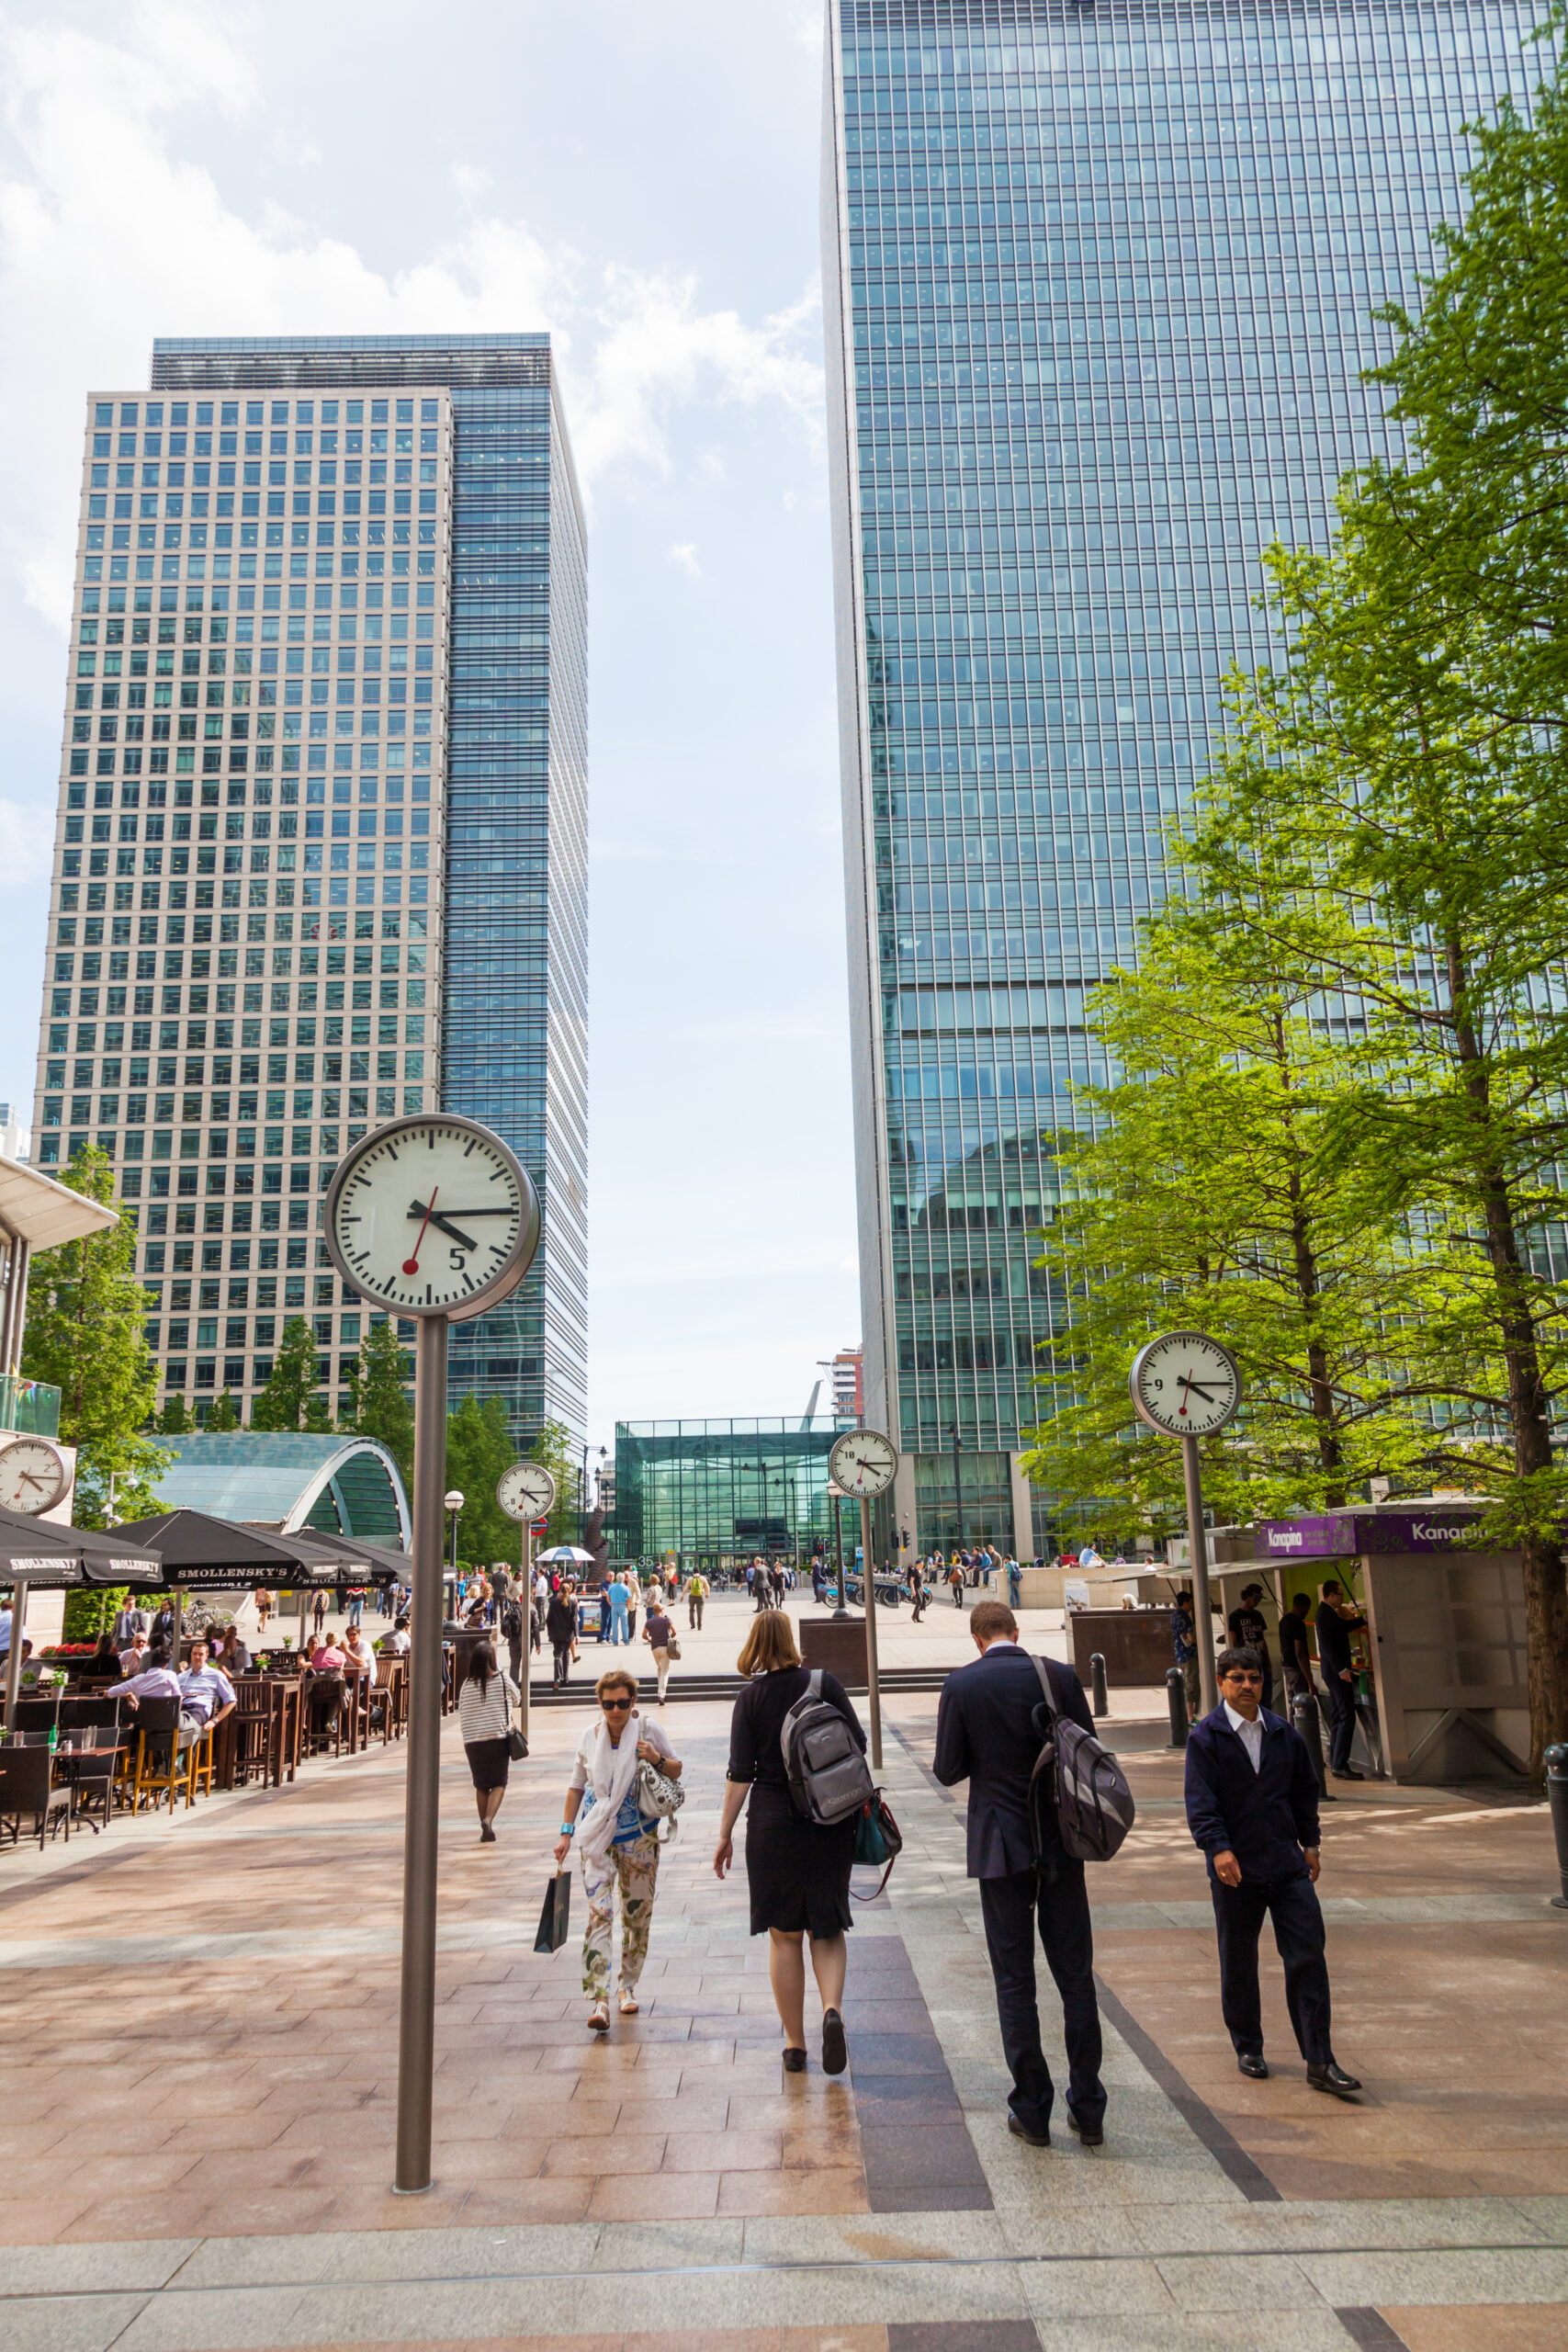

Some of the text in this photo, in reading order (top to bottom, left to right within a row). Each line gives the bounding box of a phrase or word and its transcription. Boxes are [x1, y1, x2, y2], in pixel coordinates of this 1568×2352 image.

[449, 1247, 467, 1272] 5
[1154, 1378, 1164, 1391] 9
[844, 1450, 855, 1460] 10
[43, 1463, 51, 1474] 2
[510, 1498, 516, 1506] 8
[1268, 1526, 1303, 1553] Kanapina
[637, 1555, 654, 1567] 35
[177, 1567, 288, 1578] SMOLLENSKY'S
